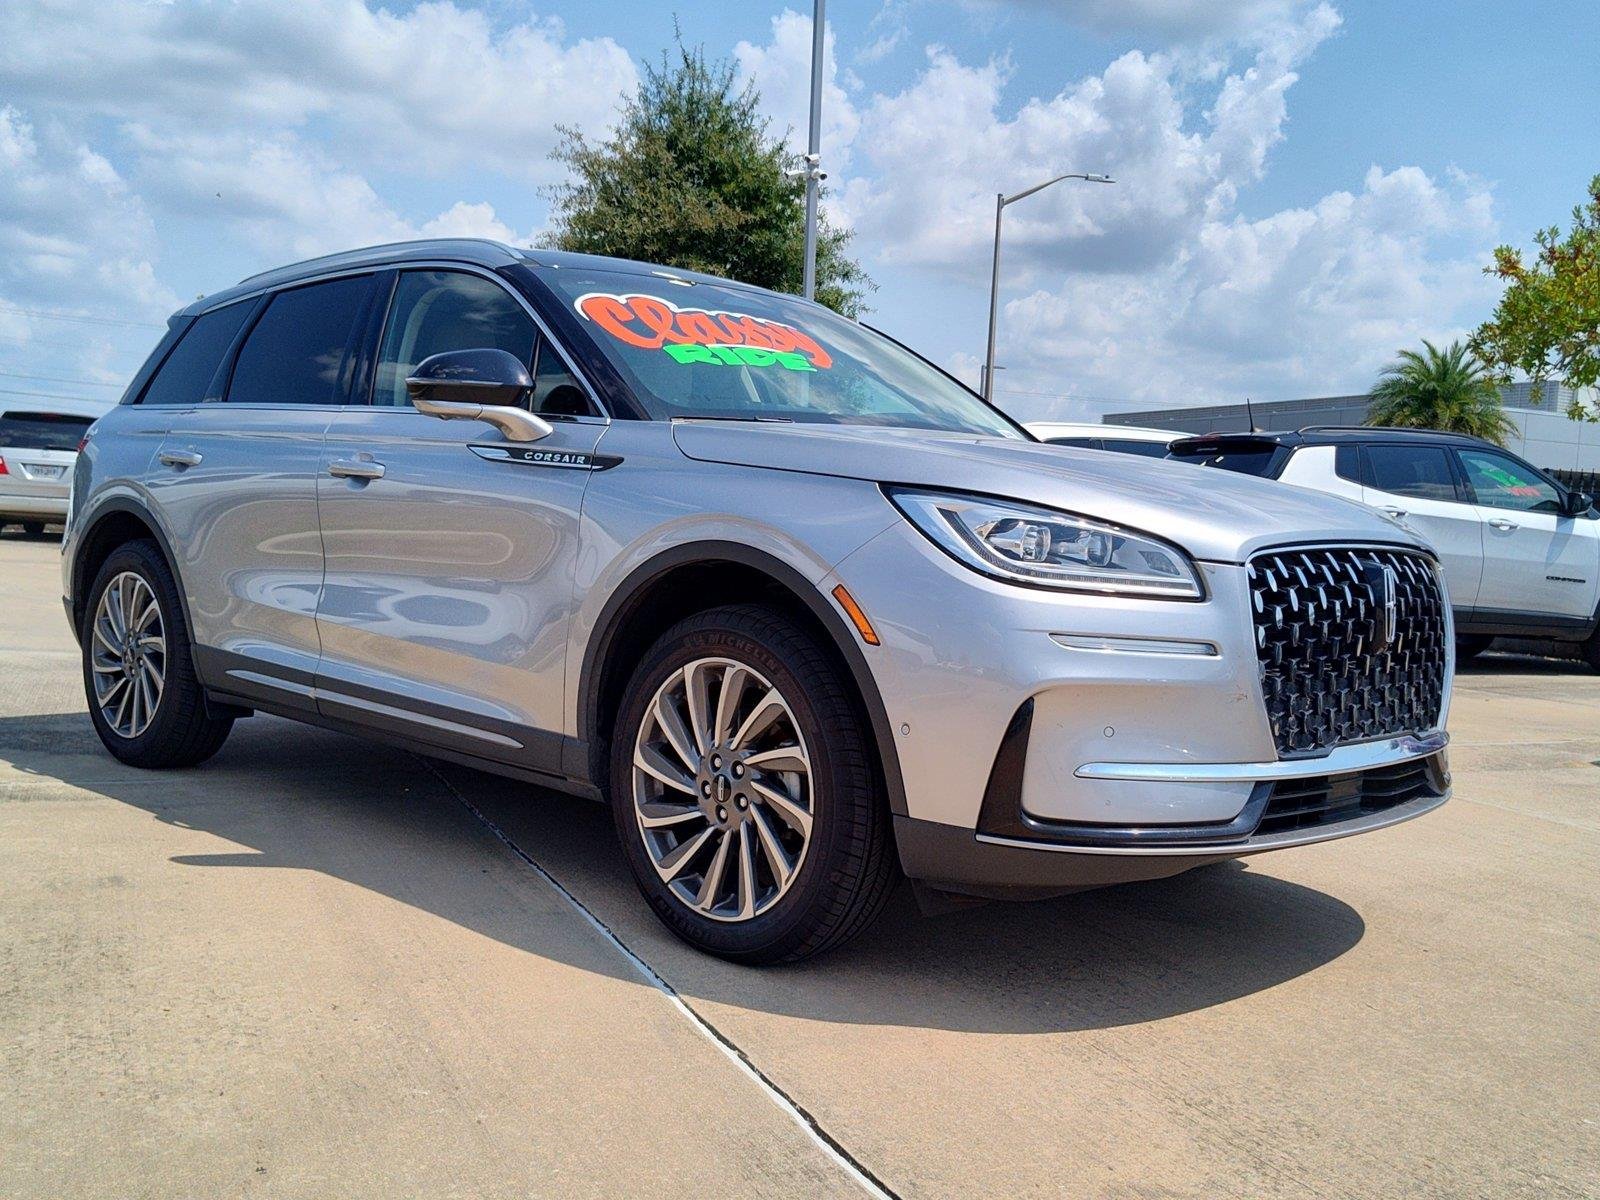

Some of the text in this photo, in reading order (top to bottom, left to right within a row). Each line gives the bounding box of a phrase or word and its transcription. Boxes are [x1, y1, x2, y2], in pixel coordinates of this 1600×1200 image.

[663, 344, 818, 371] RIDE
[523, 451, 586, 465] CORSAIR
[707, 632, 778, 672] MICHELIN
